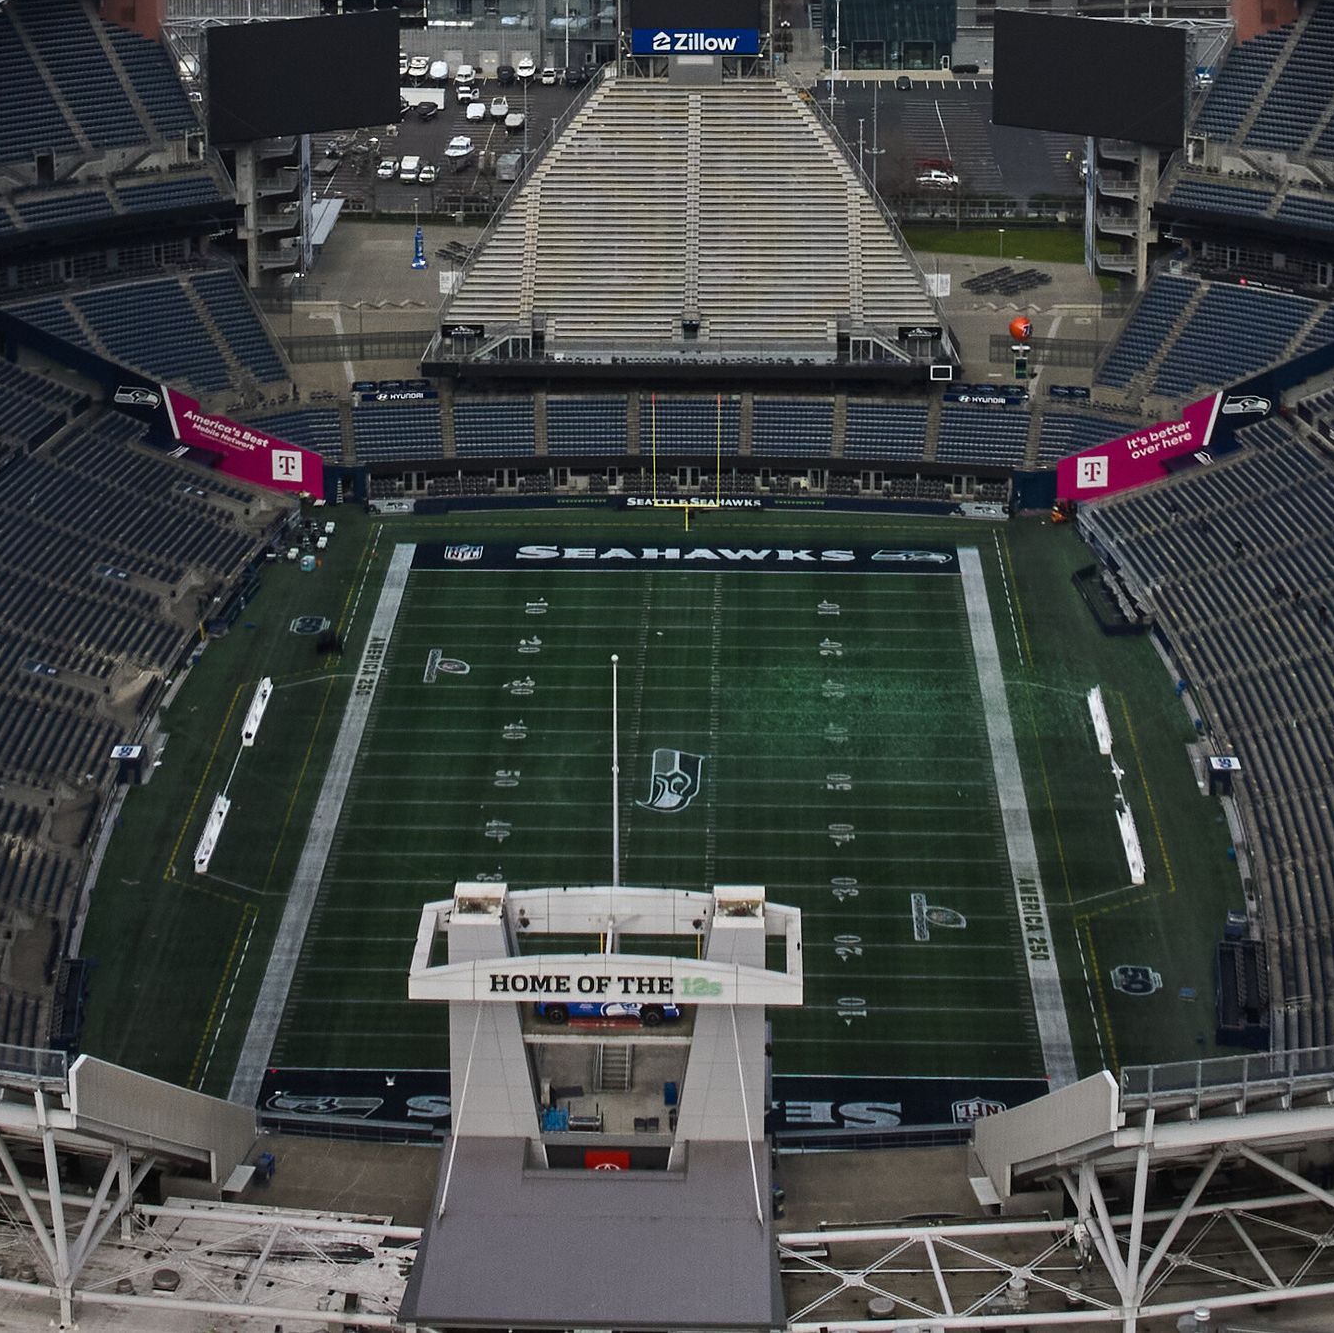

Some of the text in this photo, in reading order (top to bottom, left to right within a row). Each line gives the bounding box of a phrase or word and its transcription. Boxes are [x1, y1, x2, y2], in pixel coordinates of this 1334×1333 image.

[673, 32, 737, 50] Zillow
[390, 392, 424, 400] HYUNDAI
[971, 396, 1006, 404] HYUNDAI
[183, 410, 242, 438] America's
[242, 430, 270, 448] Best
[192, 423, 221, 440] Mobile
[220, 432, 255, 451] Network
[1126, 420, 1192, 451] It's better
[1130, 430, 1193, 460] over here
[278, 455, 296, 475] T
[1084, 462, 1101, 482] T
[515, 544, 856, 563] SEAHAWKS
[355, 636, 387, 696] AMERICA 250
[828, 823, 855, 842] 40
[830, 877, 859, 897] 30
[1015, 877, 1051, 962] AMERICA 250
[833, 934, 863, 957] 20
[489, 974, 723, 997] HOME OF THE 12s
[837, 997, 868, 1018] 10
